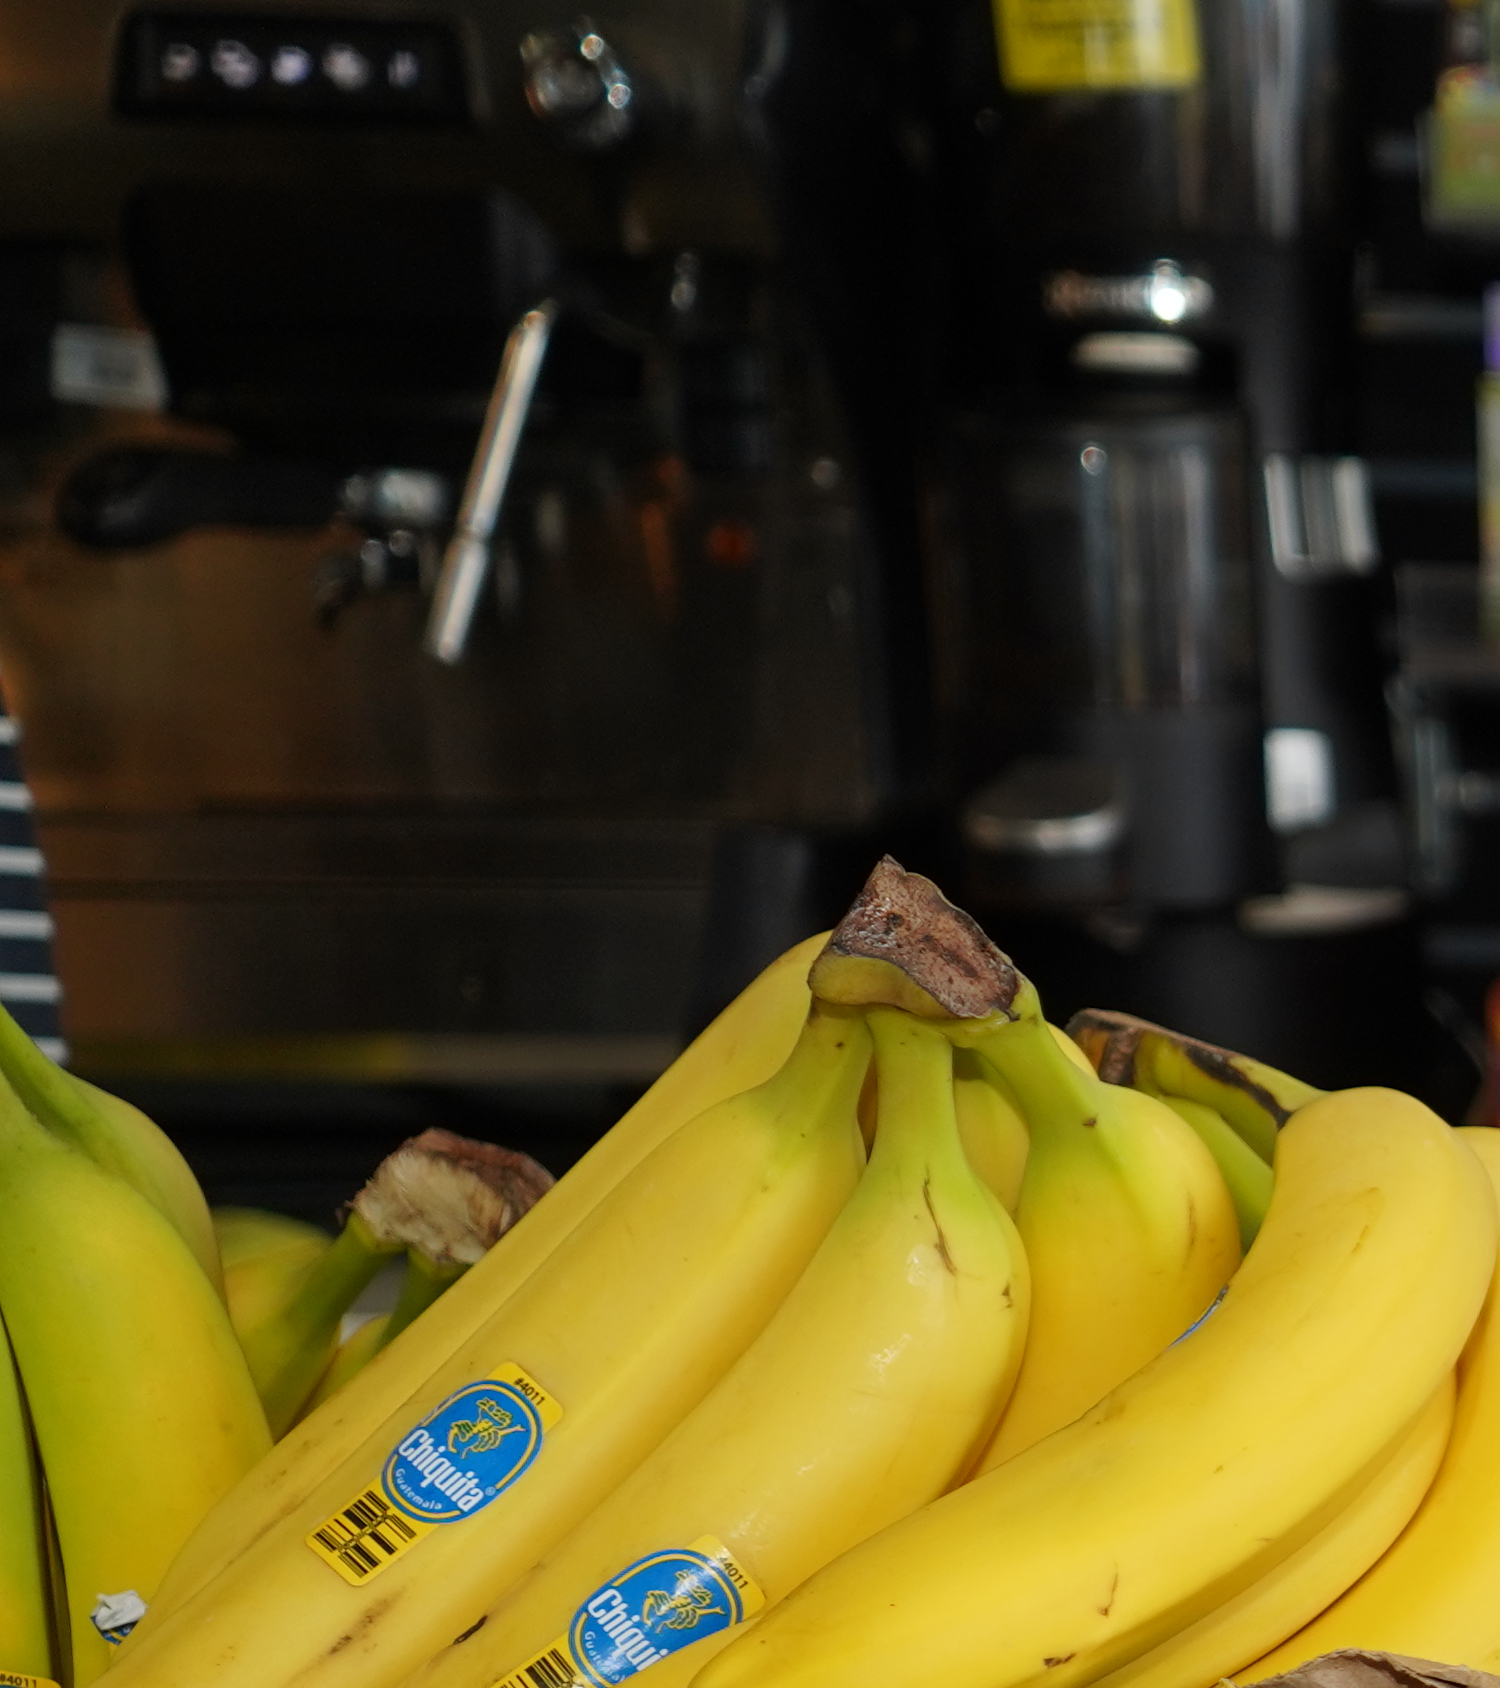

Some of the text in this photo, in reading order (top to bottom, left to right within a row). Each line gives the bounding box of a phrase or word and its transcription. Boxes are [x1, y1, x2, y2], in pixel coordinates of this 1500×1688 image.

[514, 1378, 545, 1405] #4011
[396, 1468, 442, 1509] Guatemala
[399, 1429, 483, 1512] Chiquita
[587, 1588, 669, 1672] Chiqui
